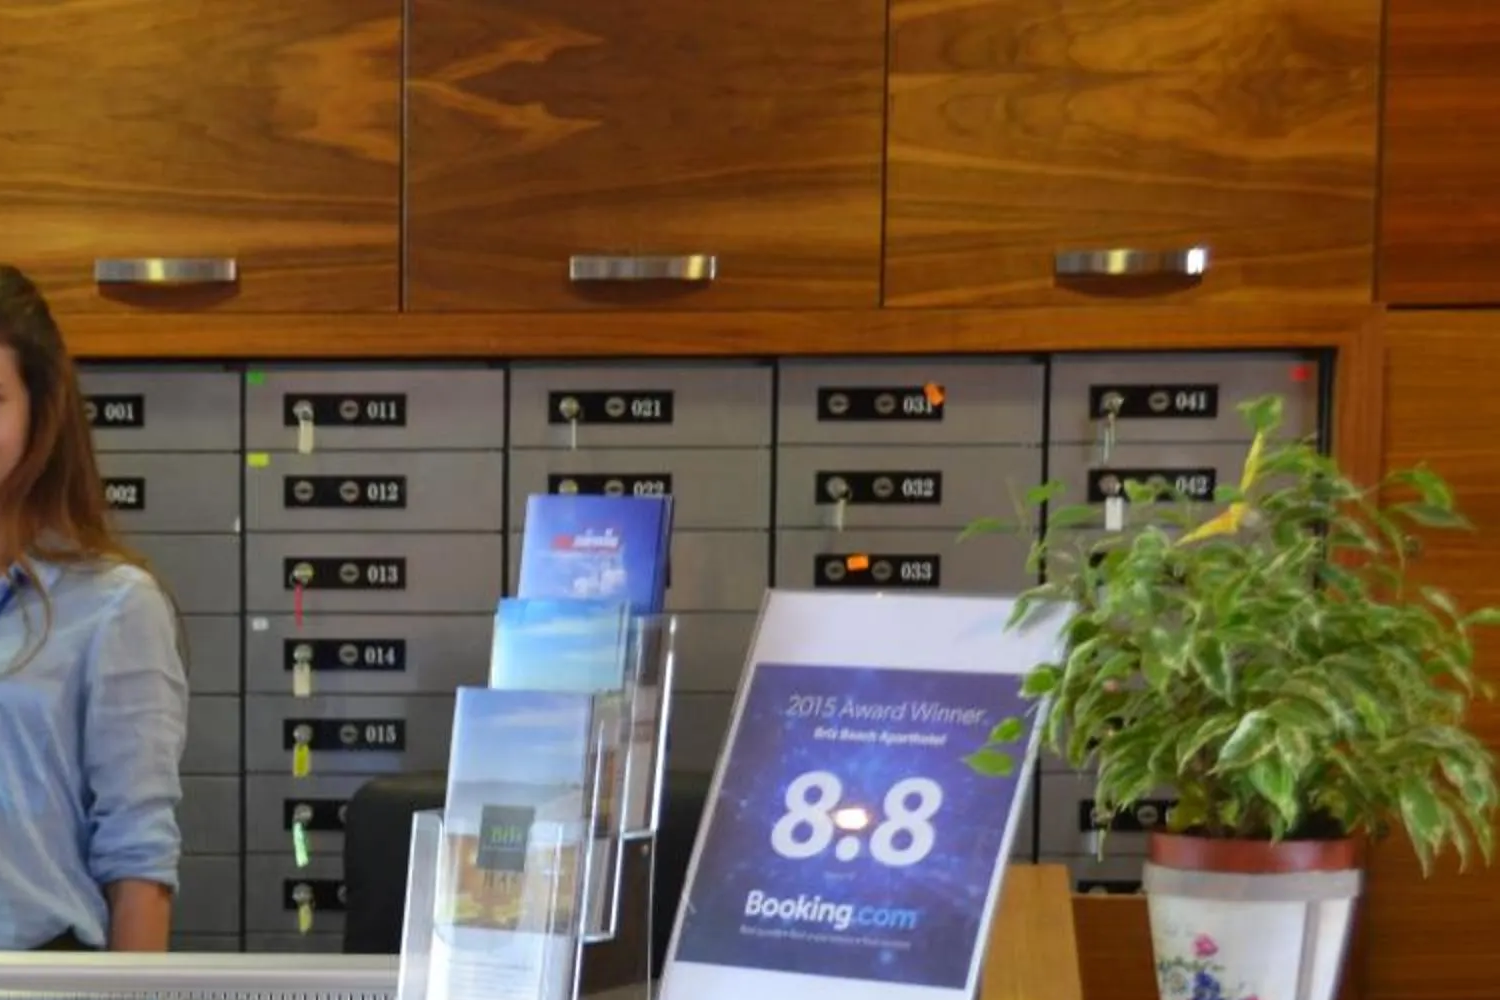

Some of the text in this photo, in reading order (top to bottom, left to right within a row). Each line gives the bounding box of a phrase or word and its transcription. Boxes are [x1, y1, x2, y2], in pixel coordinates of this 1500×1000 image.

[366, 400, 397, 420] 011
[631, 399, 661, 418] 021
[1175, 391, 1207, 411] 041
[104, 402, 135, 421] 001
[105, 484, 137, 504] 002
[367, 482, 399, 502] 012
[901, 477, 935, 497] 032
[1175, 475, 1208, 495] 042
[366, 564, 398, 584] 013
[901, 561, 933, 581] 033
[364, 646, 396, 666] 014
[786, 694, 837, 718] 2015
[839, 699, 908, 722] Award
[364, 723, 397, 744] 015
[771, 770, 944, 867] 8.8
[744, 889, 918, 931] Booking.com
